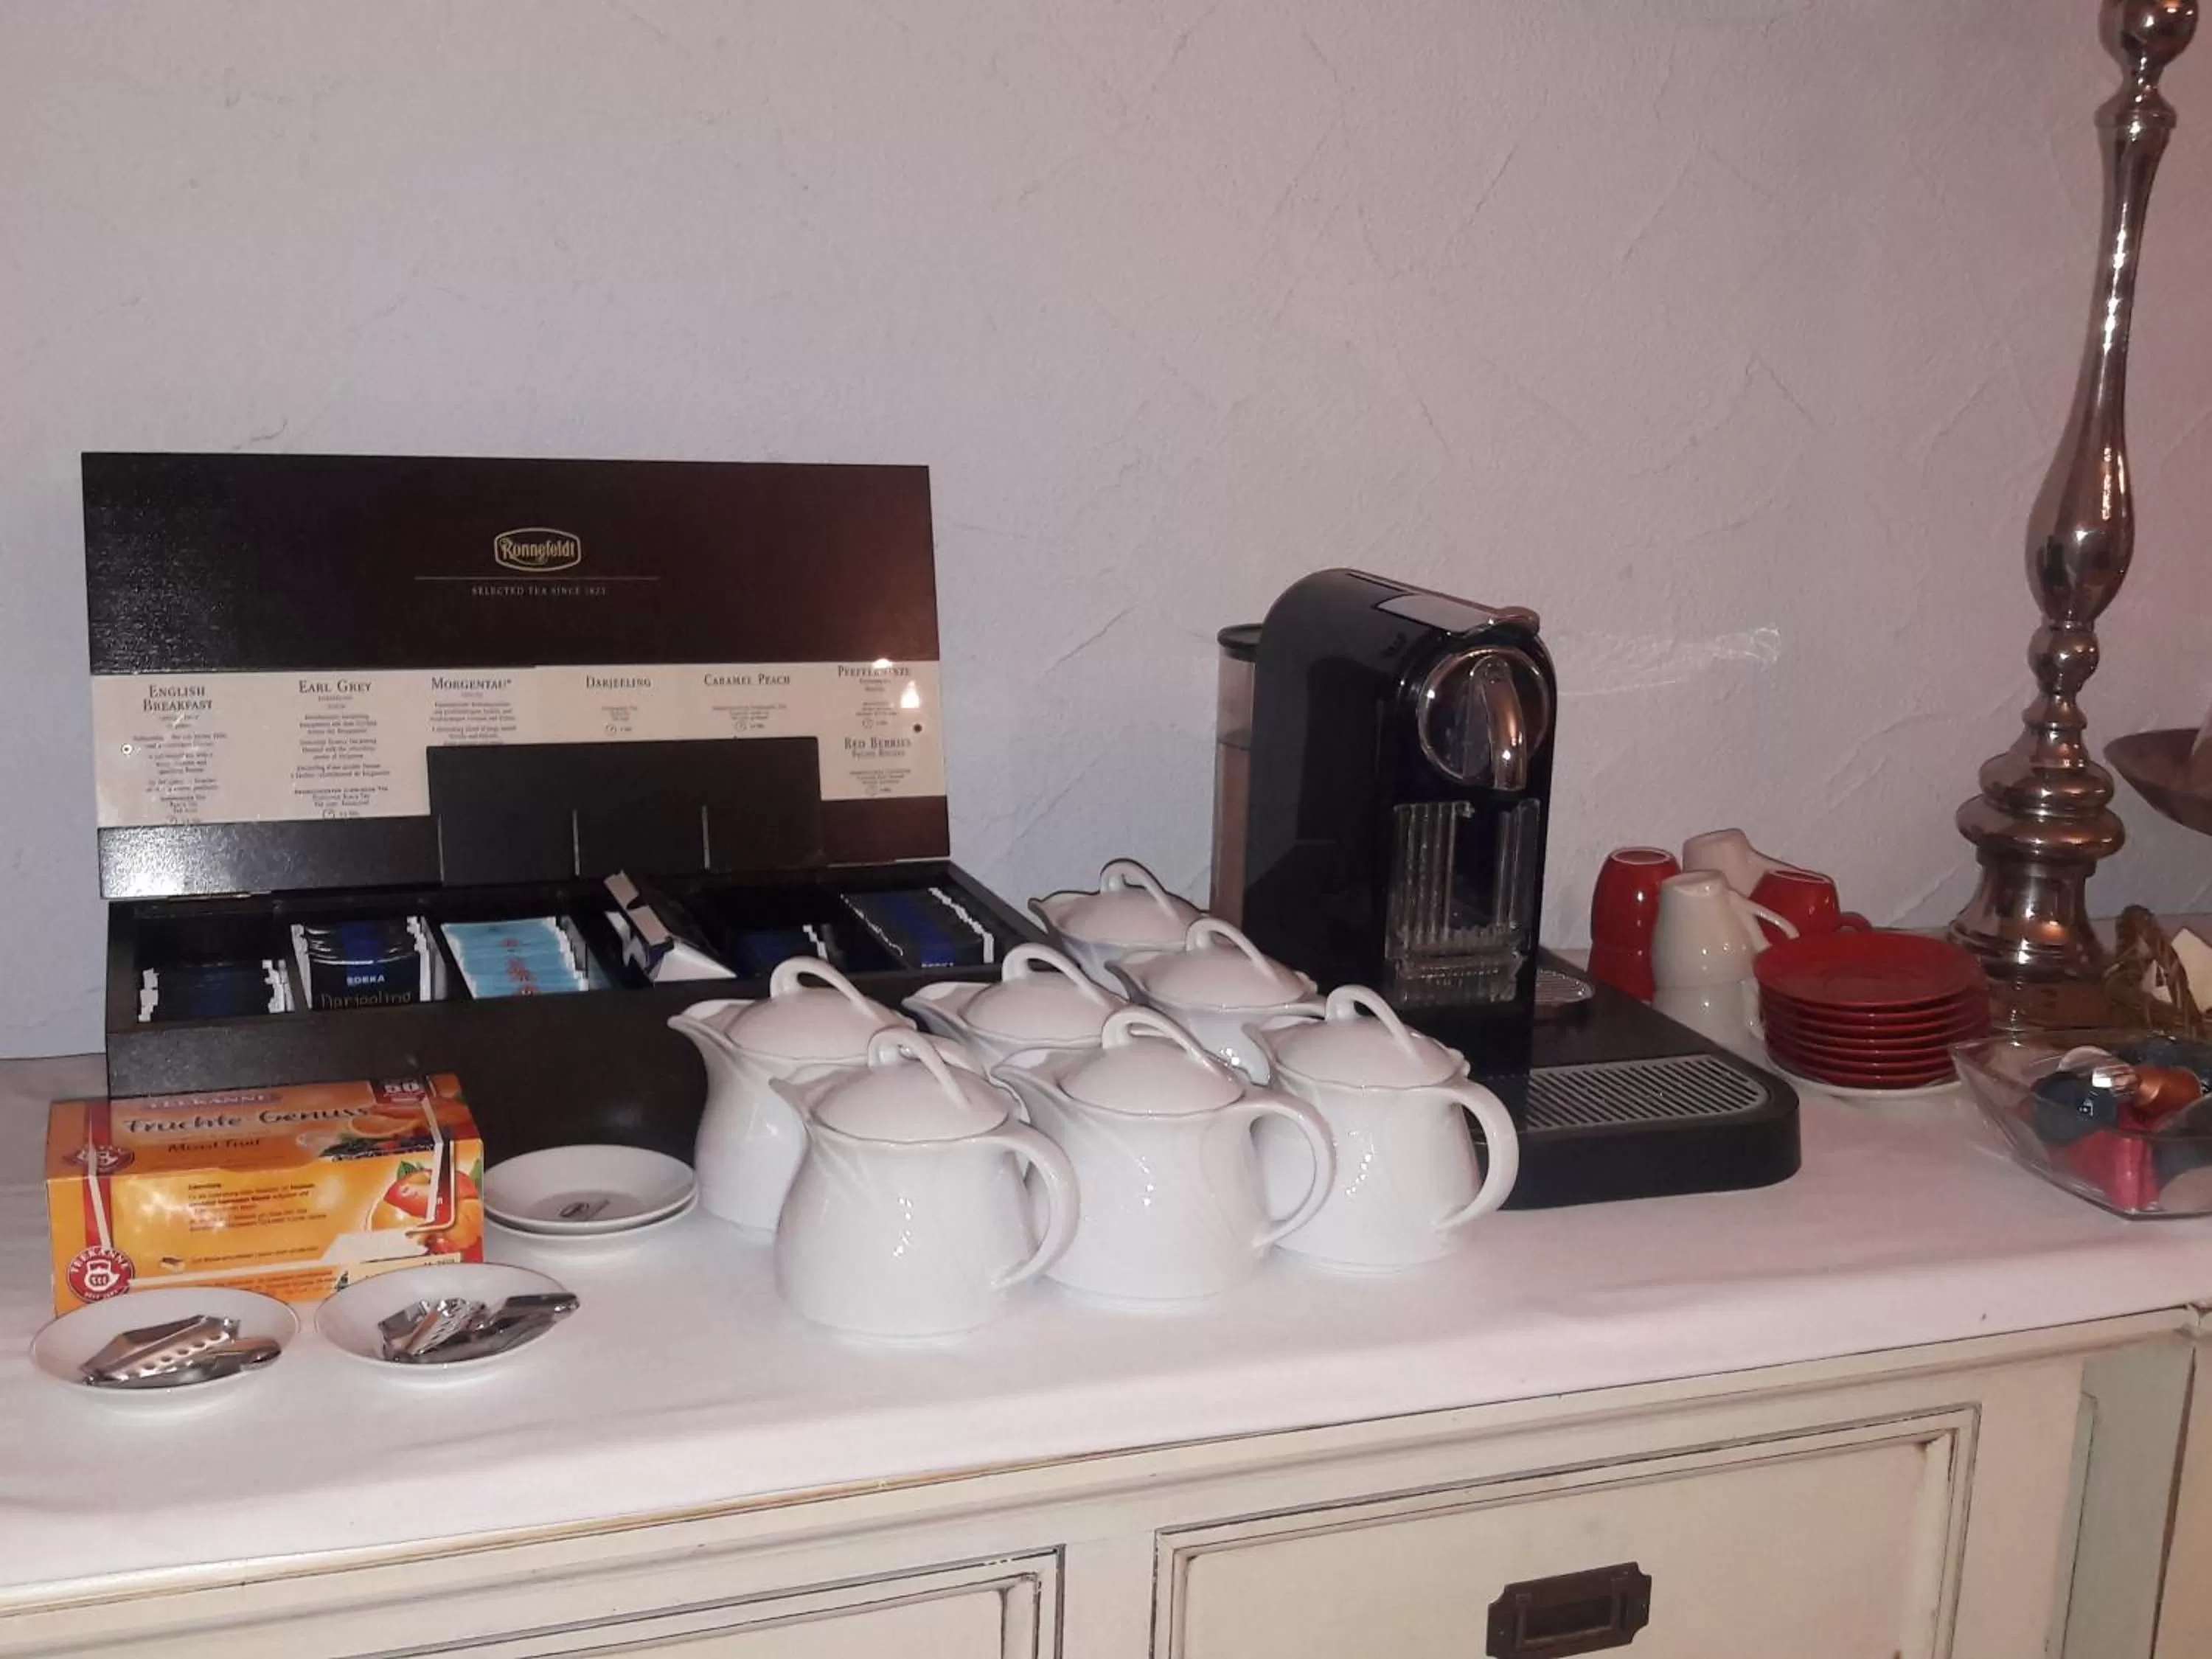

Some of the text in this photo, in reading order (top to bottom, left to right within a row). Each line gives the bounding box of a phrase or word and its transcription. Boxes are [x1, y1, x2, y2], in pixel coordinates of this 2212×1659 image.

[500, 537, 576, 566] Ronnefeldt
[470, 586, 524, 597] SELECTED
[528, 586, 548, 596] TEA
[551, 585, 580, 596] SINCE
[299, 679, 372, 693] EARL GREY
[585, 675, 652, 690] DARJEELING
[703, 673, 791, 686] CARAMEL PEACH
[149, 684, 206, 698] ENGLISH
[142, 700, 213, 712] BREAKFAST
[844, 737, 912, 750] RED BERRIES
